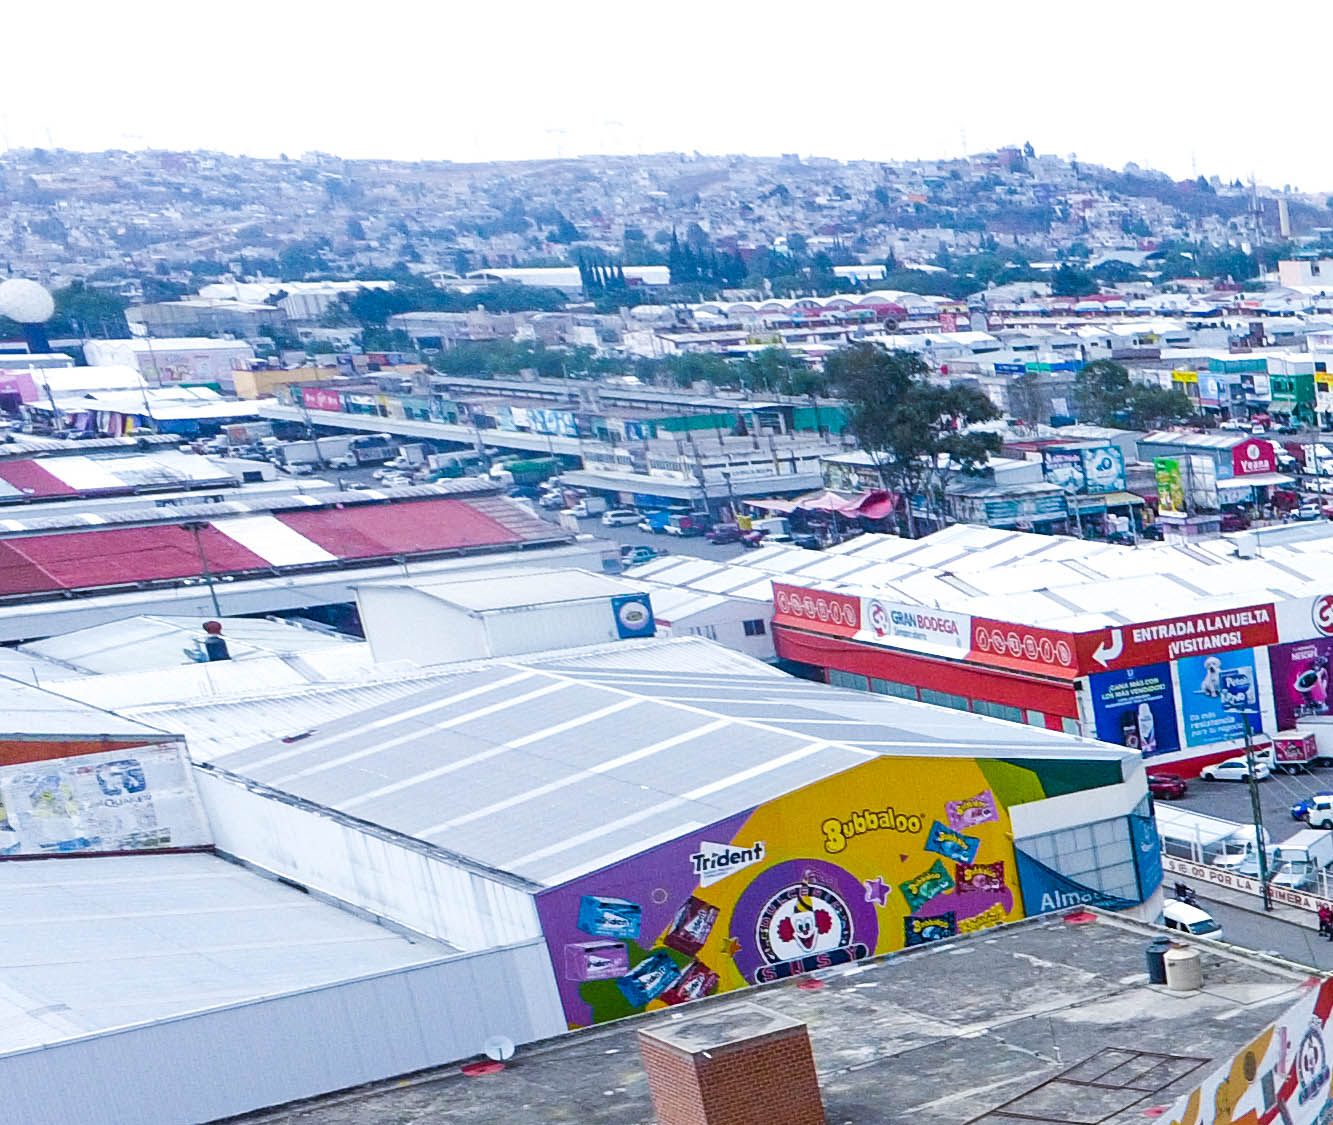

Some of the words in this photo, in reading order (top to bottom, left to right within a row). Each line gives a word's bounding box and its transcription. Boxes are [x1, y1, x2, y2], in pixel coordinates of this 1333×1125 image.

[890, 610, 917, 628] GRAN
[917, 615, 959, 635] BODEGA
[1132, 623, 1195, 643] ENTRADA
[1196, 621, 1206, 633] A
[1206, 617, 1222, 631] LA
[1222, 609, 1270, 628] VUELTA
[822, 807, 922, 853] Bubbaloo
[692, 842, 764, 872] Trident
[1236, 878, 1252, 890] LA
